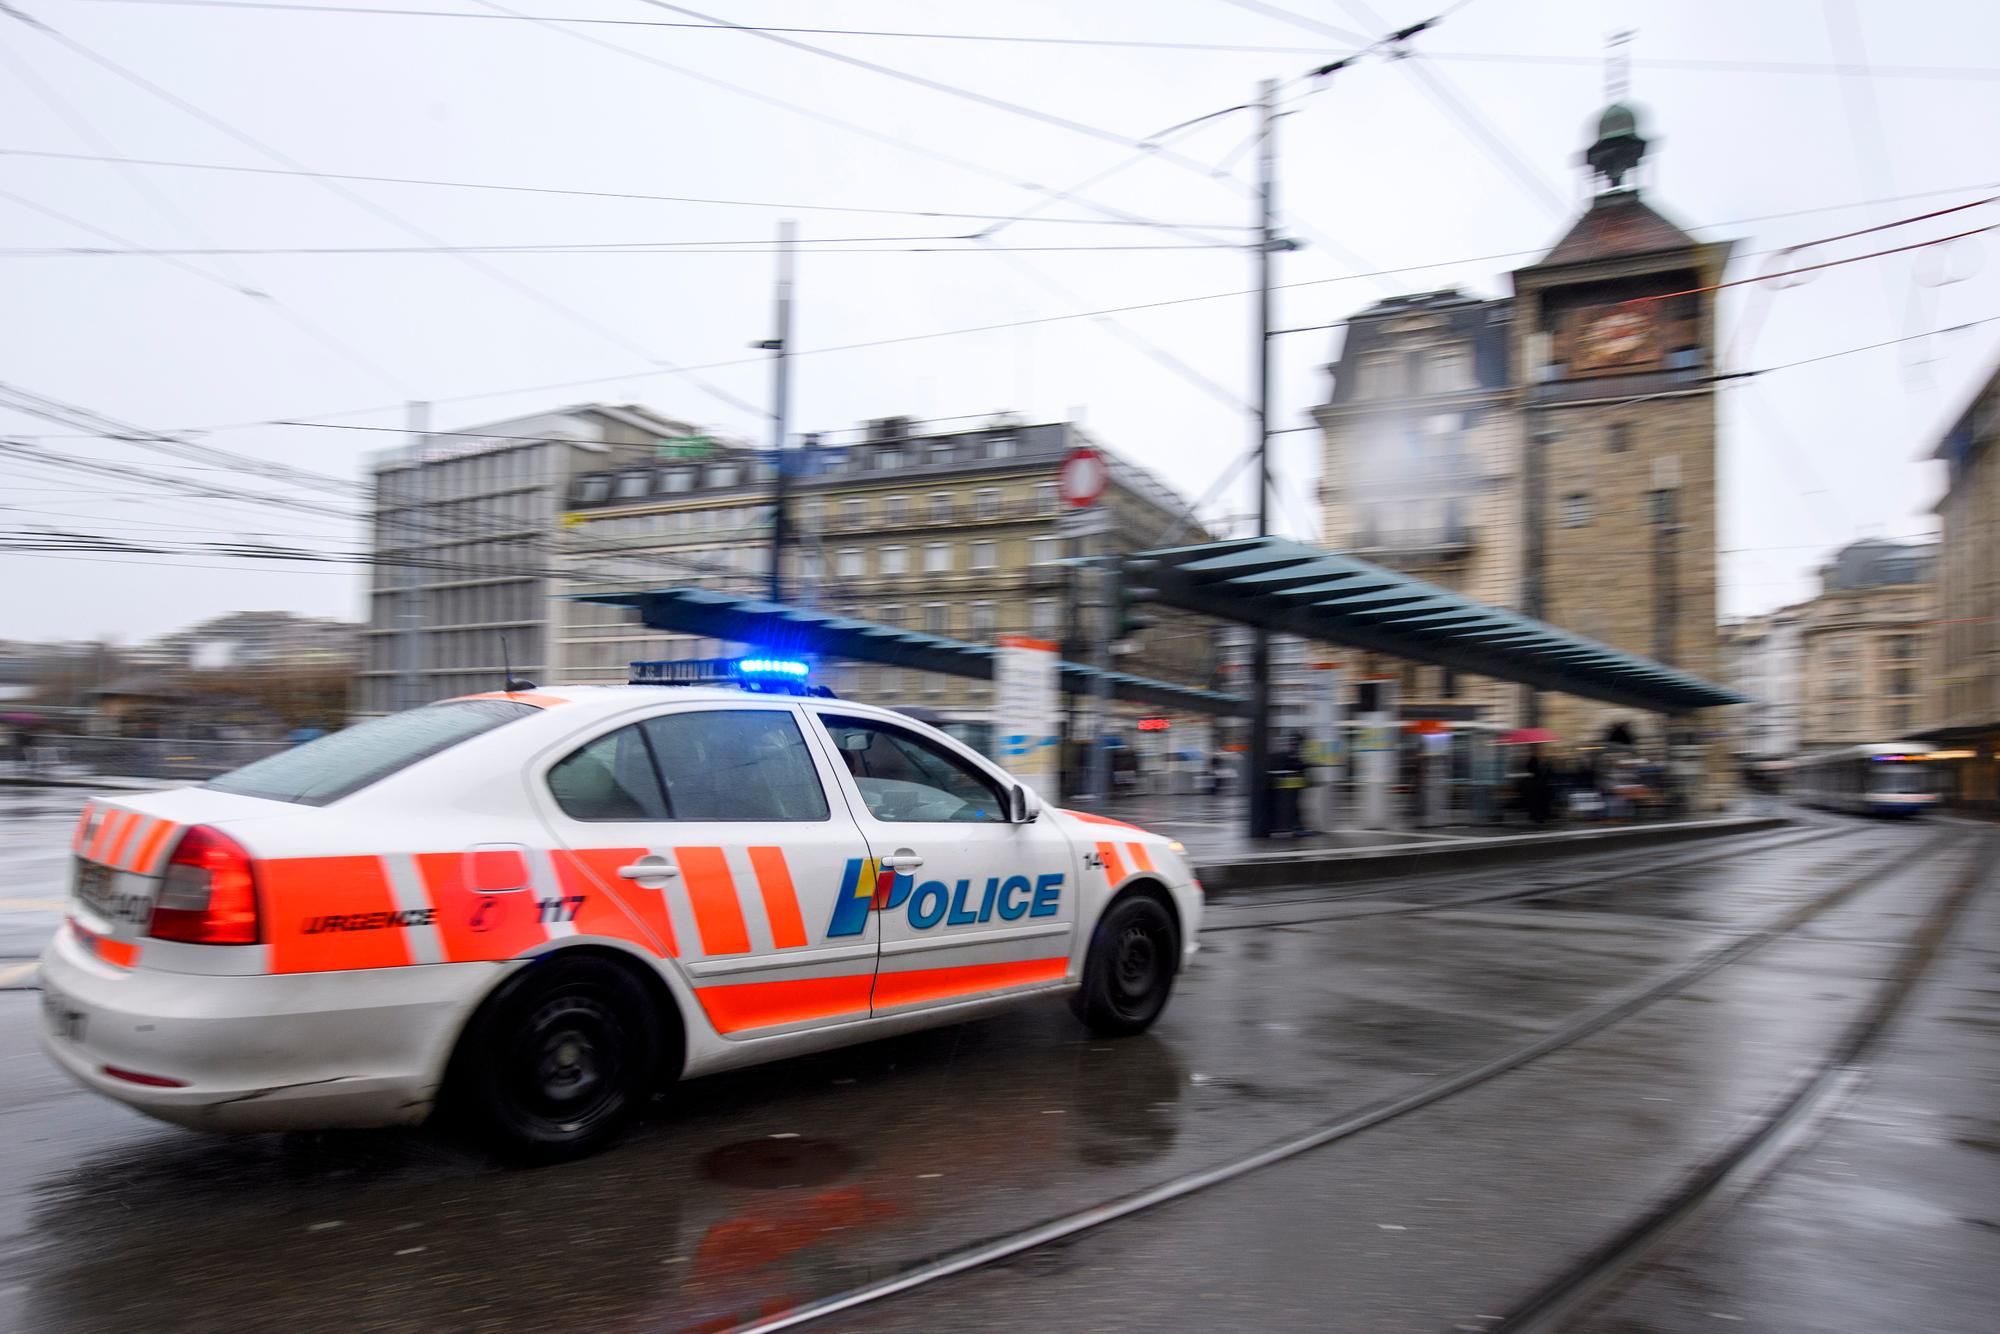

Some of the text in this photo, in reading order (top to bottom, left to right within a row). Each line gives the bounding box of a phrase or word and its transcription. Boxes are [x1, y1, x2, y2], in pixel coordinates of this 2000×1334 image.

[535, 896, 586, 923] 117
[827, 857, 1065, 938] POLICE
[300, 908, 438, 934] URGENCE
